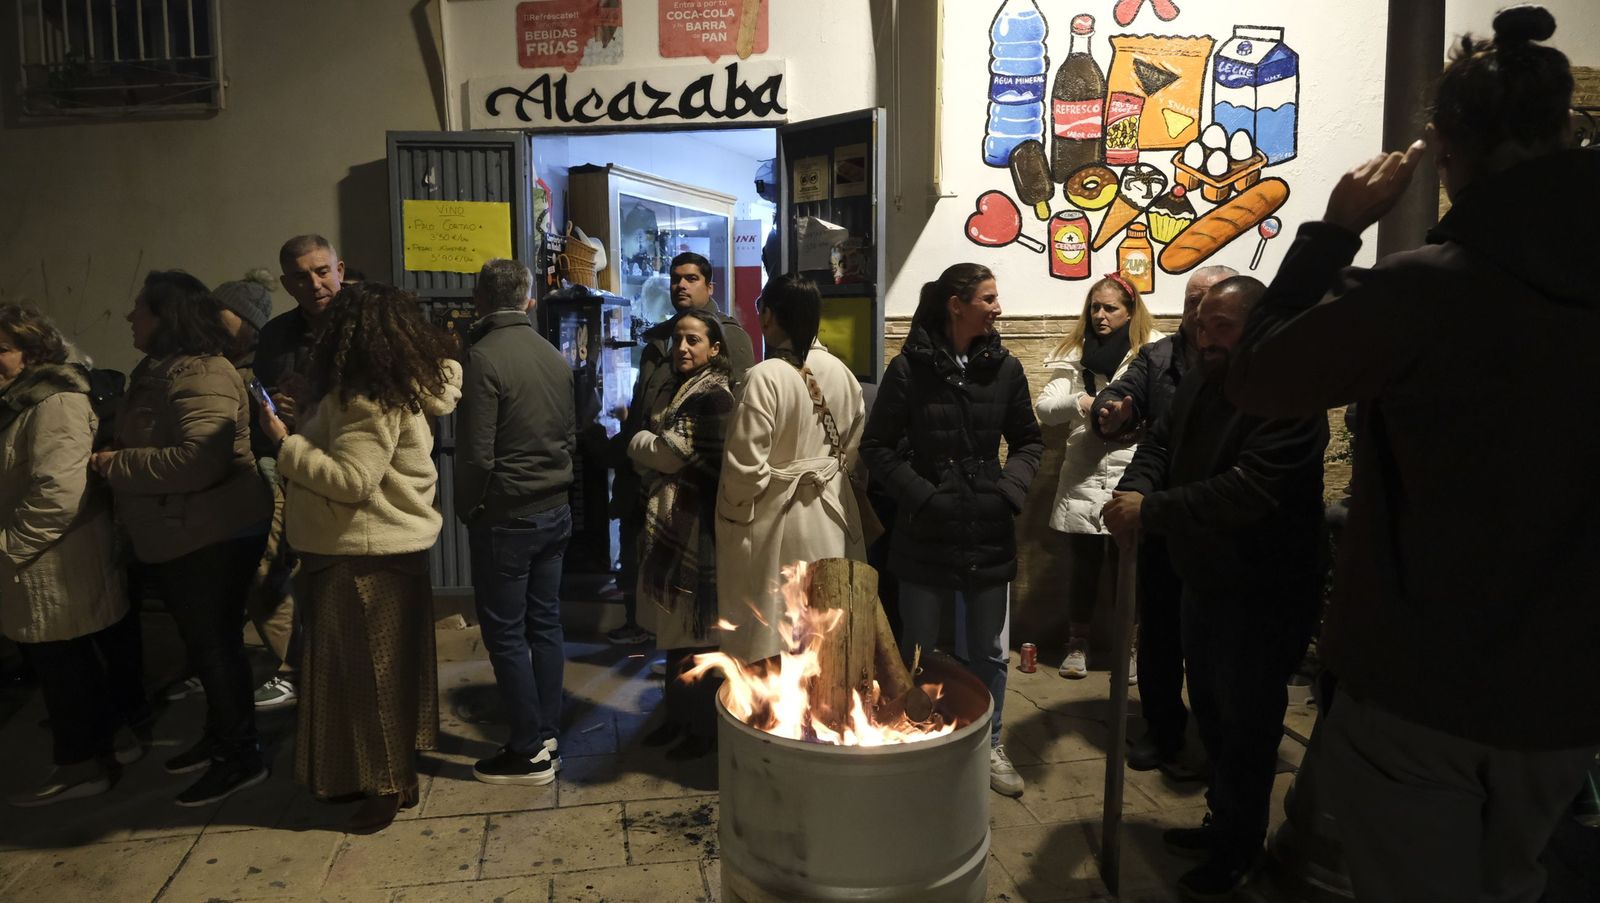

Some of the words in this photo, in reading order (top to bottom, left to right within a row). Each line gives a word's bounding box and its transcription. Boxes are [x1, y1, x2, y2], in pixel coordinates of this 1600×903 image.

[673, 1, 695, 9] Entra
[666, 8, 735, 20] COCA-COLA
[686, 20, 727, 31] BARRA
[525, 28, 577, 41] BEBIDAS
[702, 32, 727, 43] PAN
[526, 40, 579, 57] FRÍAS
[1217, 61, 1255, 77] LECHE
[993, 76, 1013, 85] AGUA
[1015, 75, 1045, 85] MINERAL
[485, 62, 788, 123] Alcazaba
[1055, 104, 1100, 115] REFRESCO
[437, 205, 465, 215] VINO
[1055, 243, 1086, 251] CERVEZA
